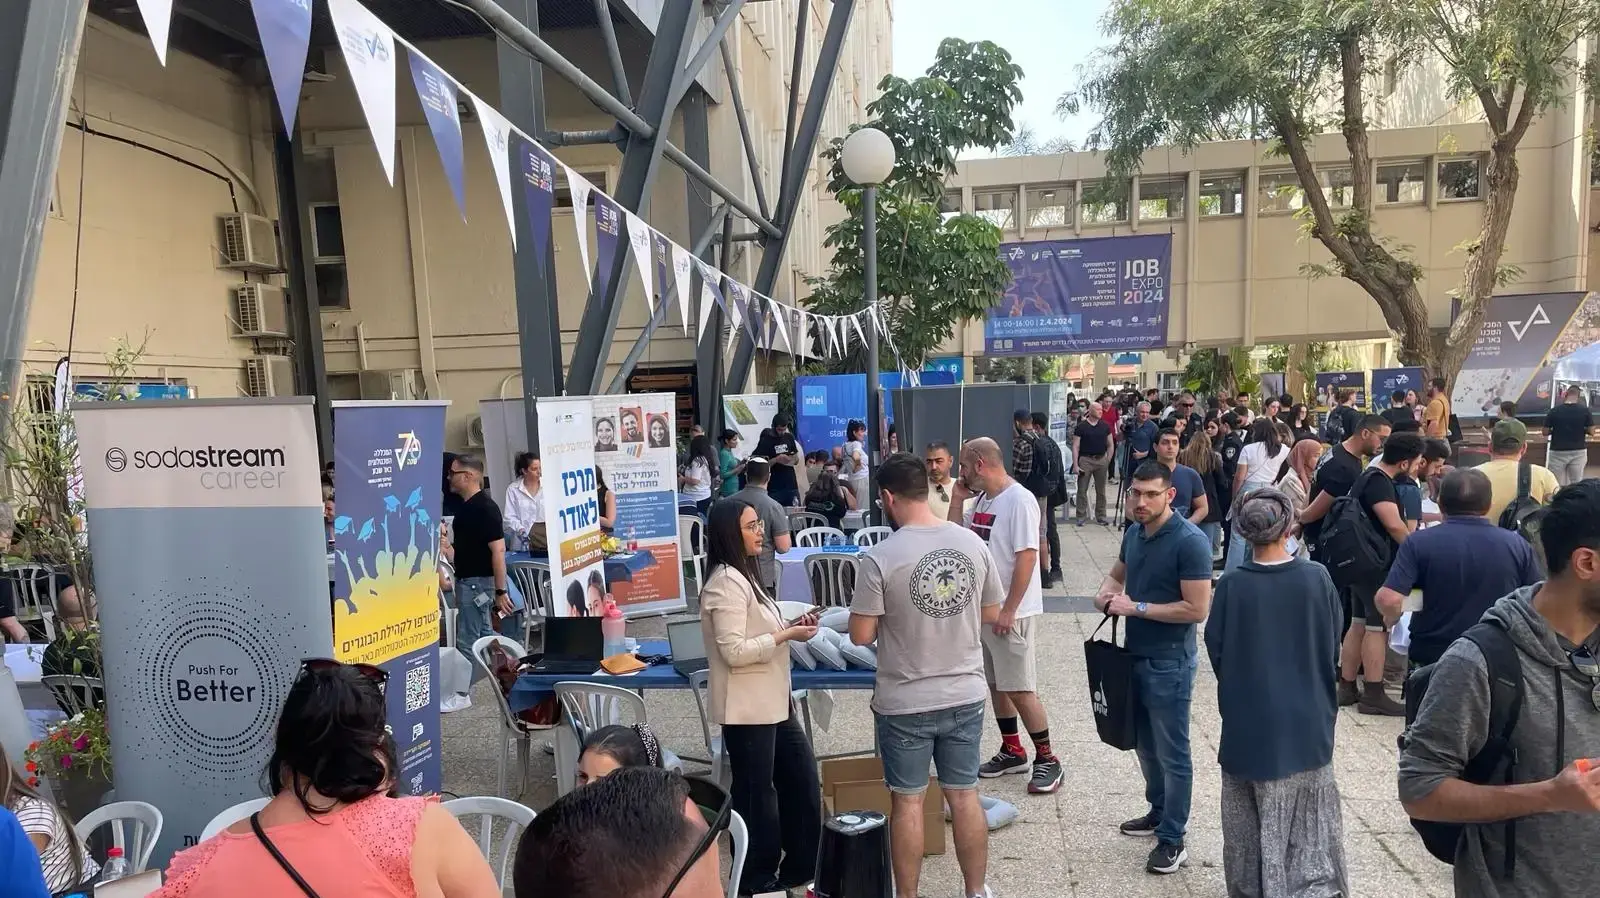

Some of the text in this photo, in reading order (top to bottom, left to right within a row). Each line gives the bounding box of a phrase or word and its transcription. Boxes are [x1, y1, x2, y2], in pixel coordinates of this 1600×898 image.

[1124, 259, 1159, 280] JOB
[1132, 276, 1163, 290] EXPO
[1123, 289, 1164, 305] 2024
[1039, 318, 1072, 326] 2.4.2024
[951, 364, 958, 373] B
[805, 395, 824, 405] intel
[829, 415, 847, 425] The
[133, 446, 285, 469] sodastream
[373, 448, 393, 457] המכללה
[372, 466, 392, 475] באר שבע
[611, 470, 660, 482] העתיד שלך
[200, 471, 285, 490] career
[561, 468, 595, 497] מרכז
[614, 480, 658, 492] מתחיל כאן
[559, 497, 598, 533] לאודר
[562, 548, 602, 571] את התעסוקה בנגב
[380, 618, 412, 641] לקהילת
[342, 632, 379, 653] הבוגרים
[410, 630, 433, 646] המכללה
[375, 638, 409, 659] הטכנולוגית
[188, 664, 239, 676] Push For
[176, 679, 256, 703] Better
